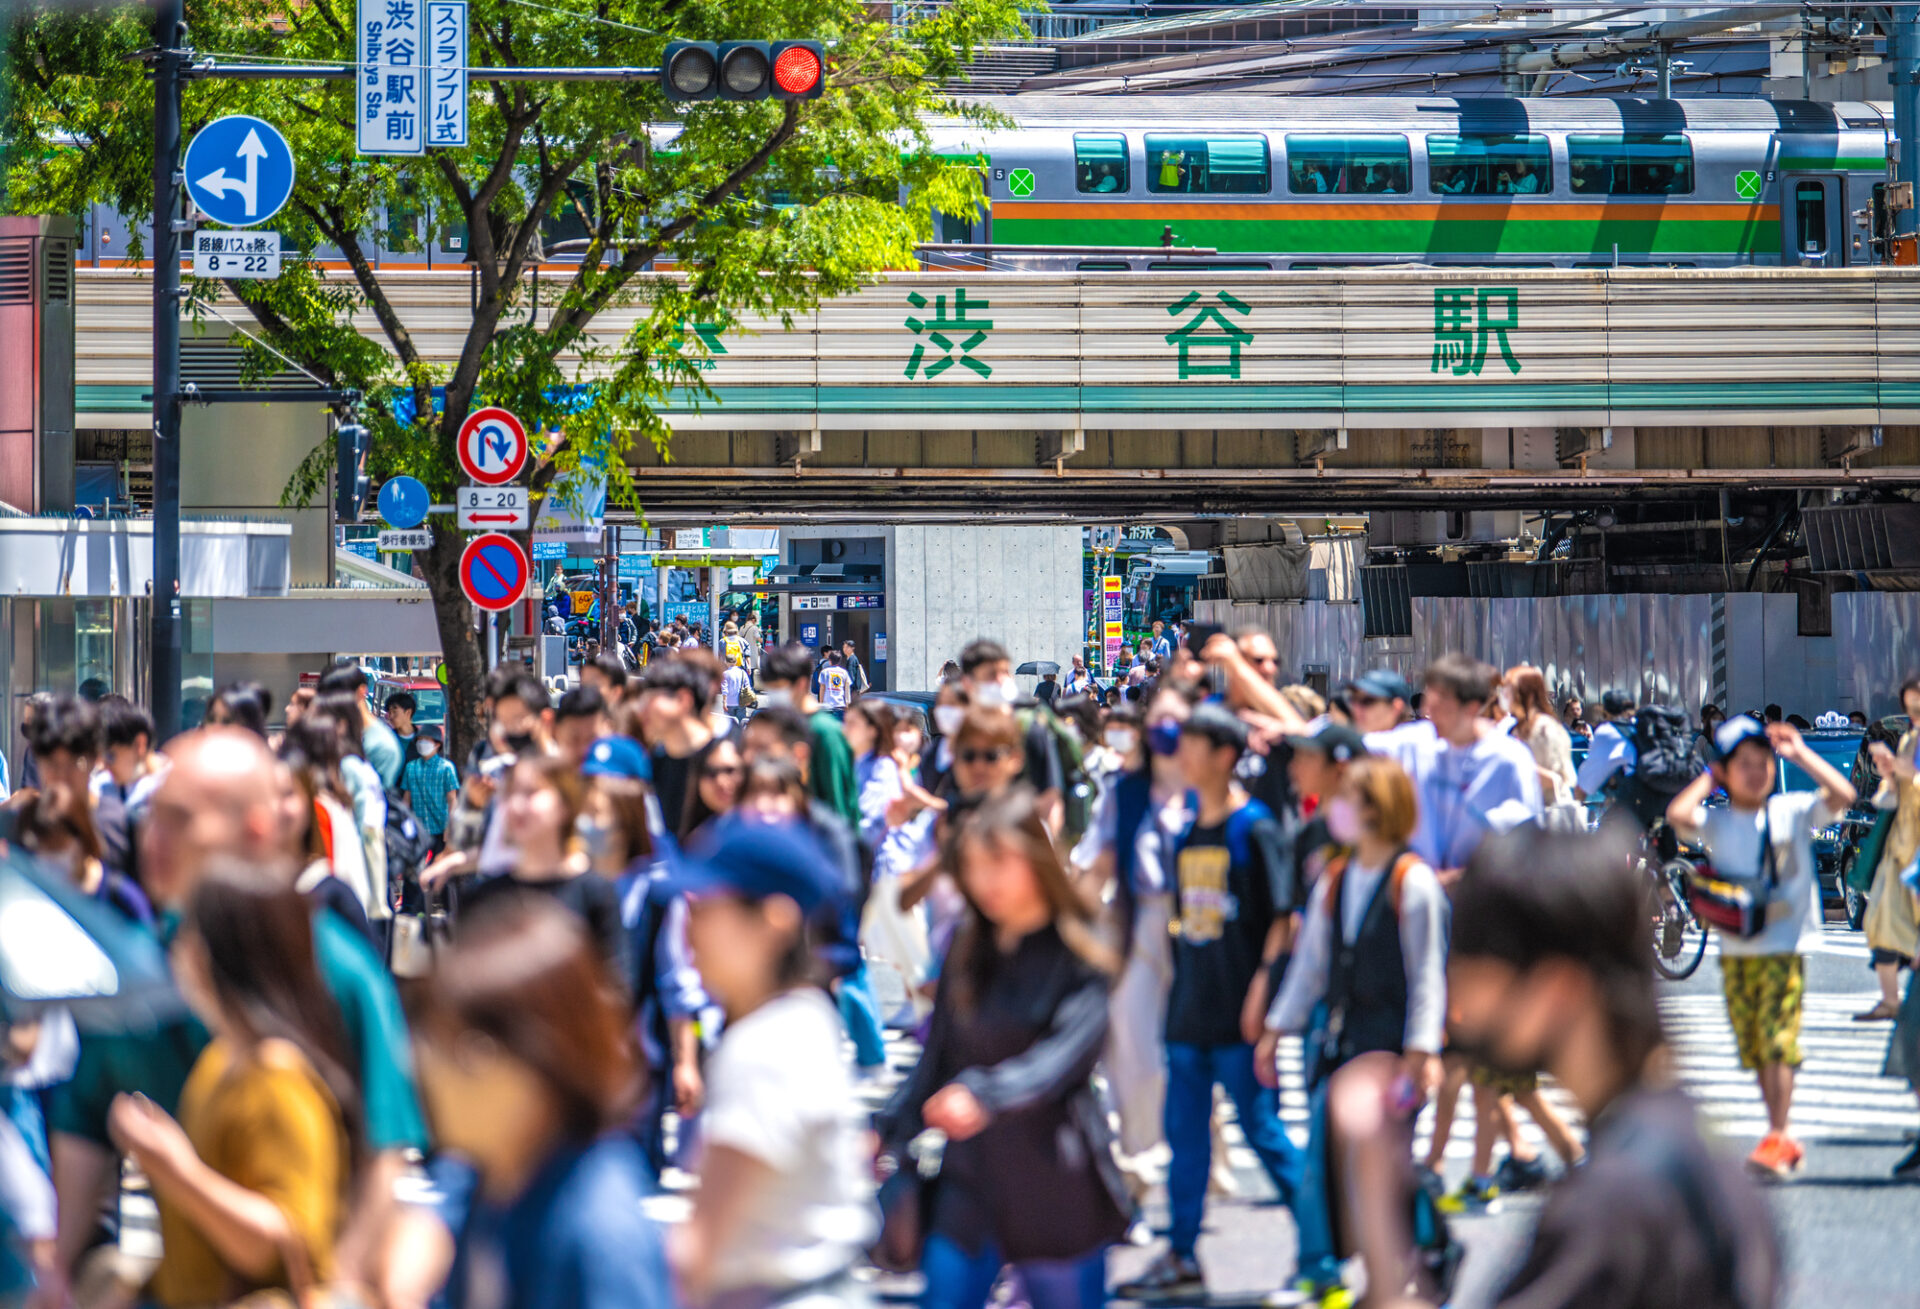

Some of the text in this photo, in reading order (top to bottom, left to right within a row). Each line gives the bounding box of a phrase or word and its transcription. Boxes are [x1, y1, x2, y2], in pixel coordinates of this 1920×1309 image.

[364, 21, 382, 124] Shibuya Sta.
[385, 0, 416, 140] 渋谷駅前
[436, 8, 459, 139] スクランブル式
[996, 170, 1003, 180] 5
[1767, 171, 1774, 181] 5
[199, 237, 275, 253] 路線バスを除く
[381, 534, 426, 547] 歩行者優先
[765, 559, 773, 569] 51
